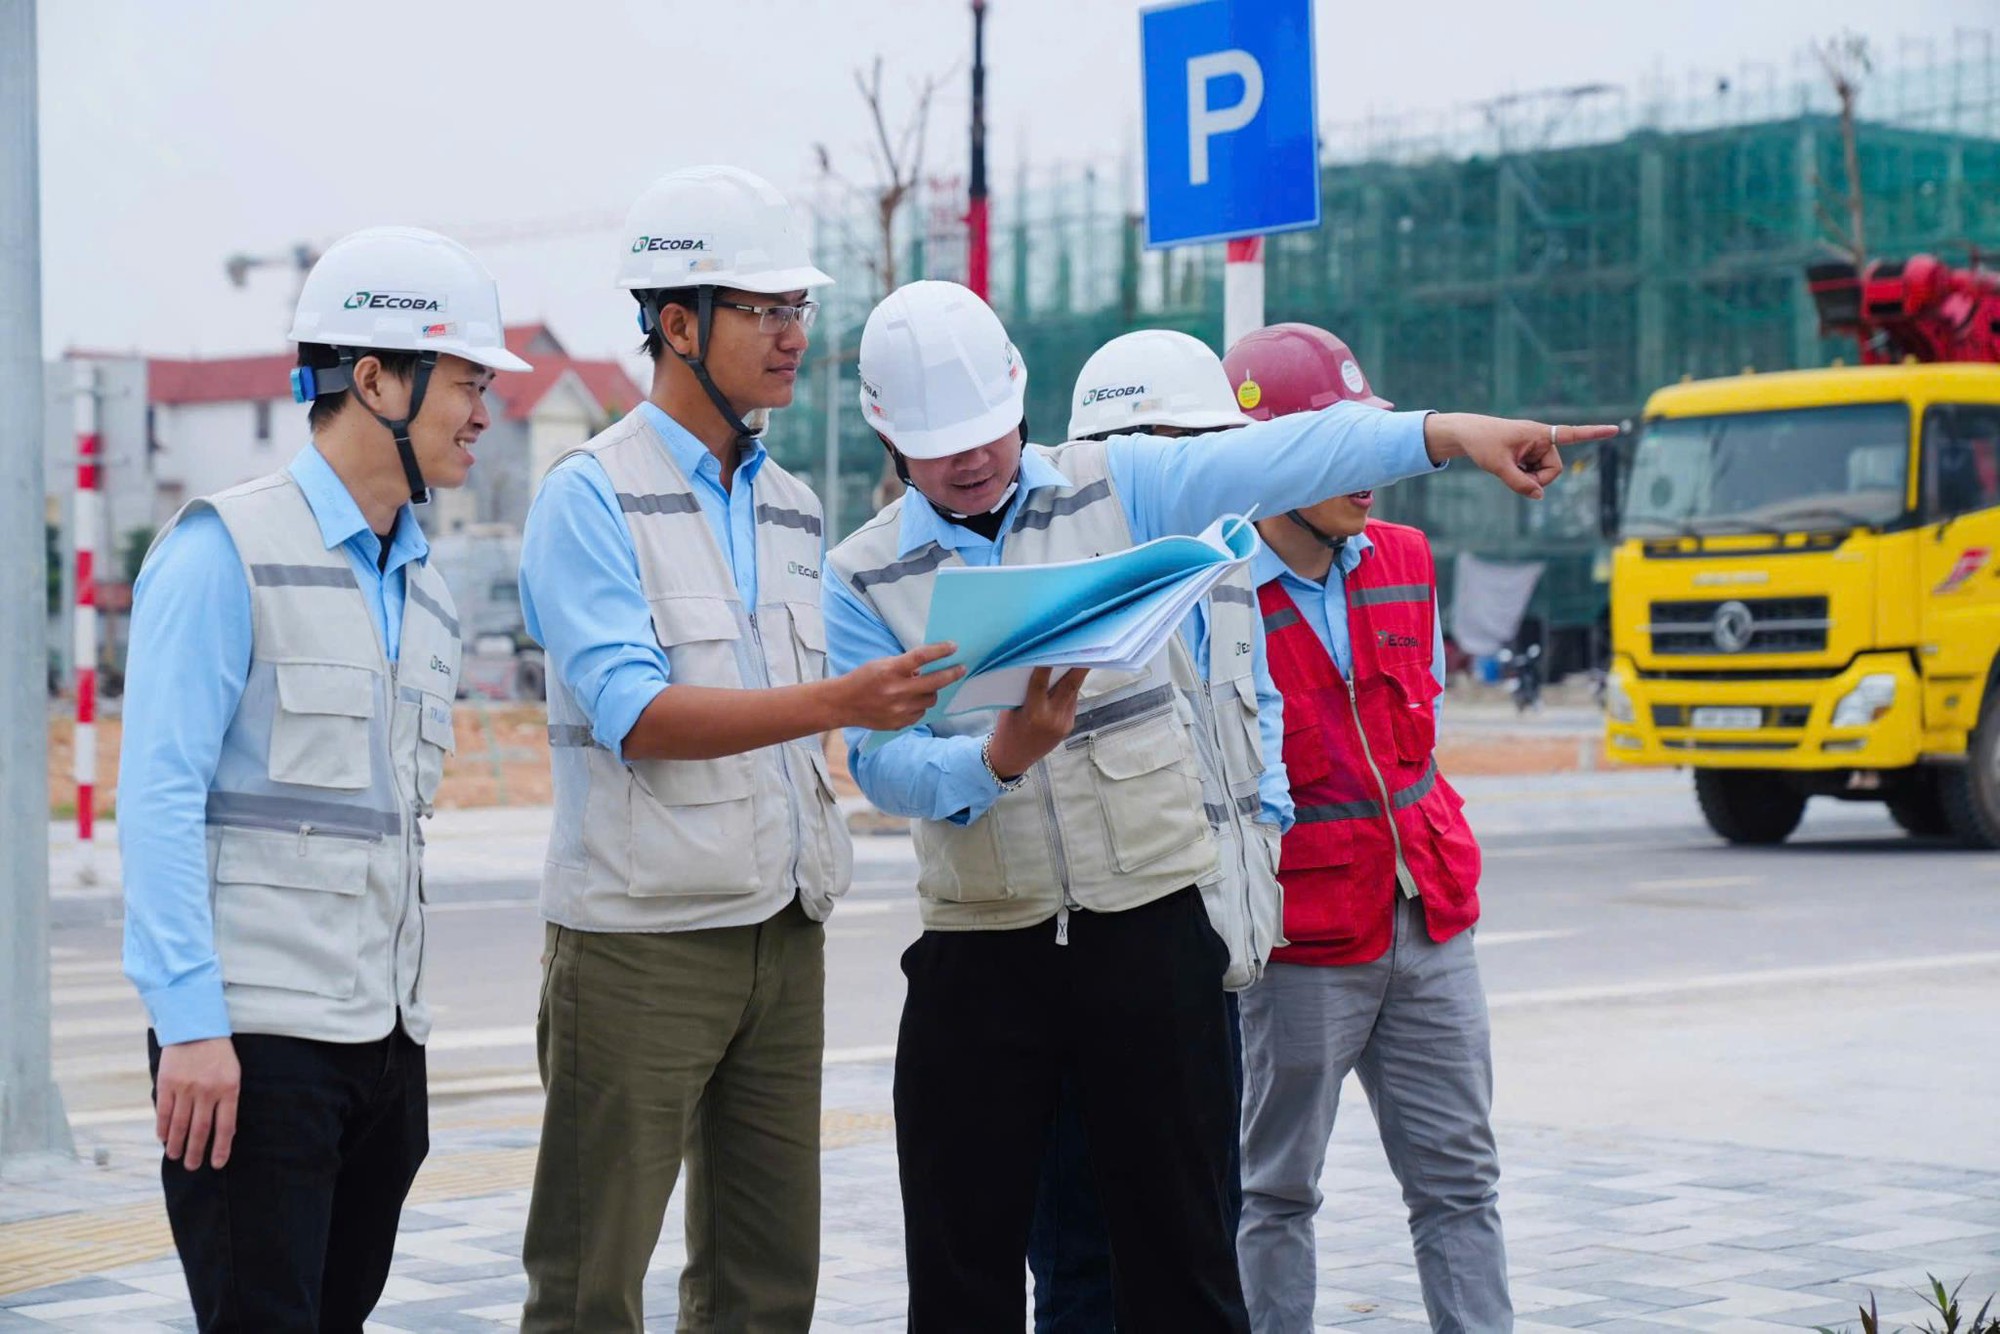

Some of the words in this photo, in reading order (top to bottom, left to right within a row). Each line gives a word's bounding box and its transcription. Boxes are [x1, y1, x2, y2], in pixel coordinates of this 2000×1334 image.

[1187, 48, 1264, 186] P
[647, 237, 704, 251] ECOBA
[369, 294, 438, 311] ECOBA
[1096, 385, 1145, 401] ECOBA
